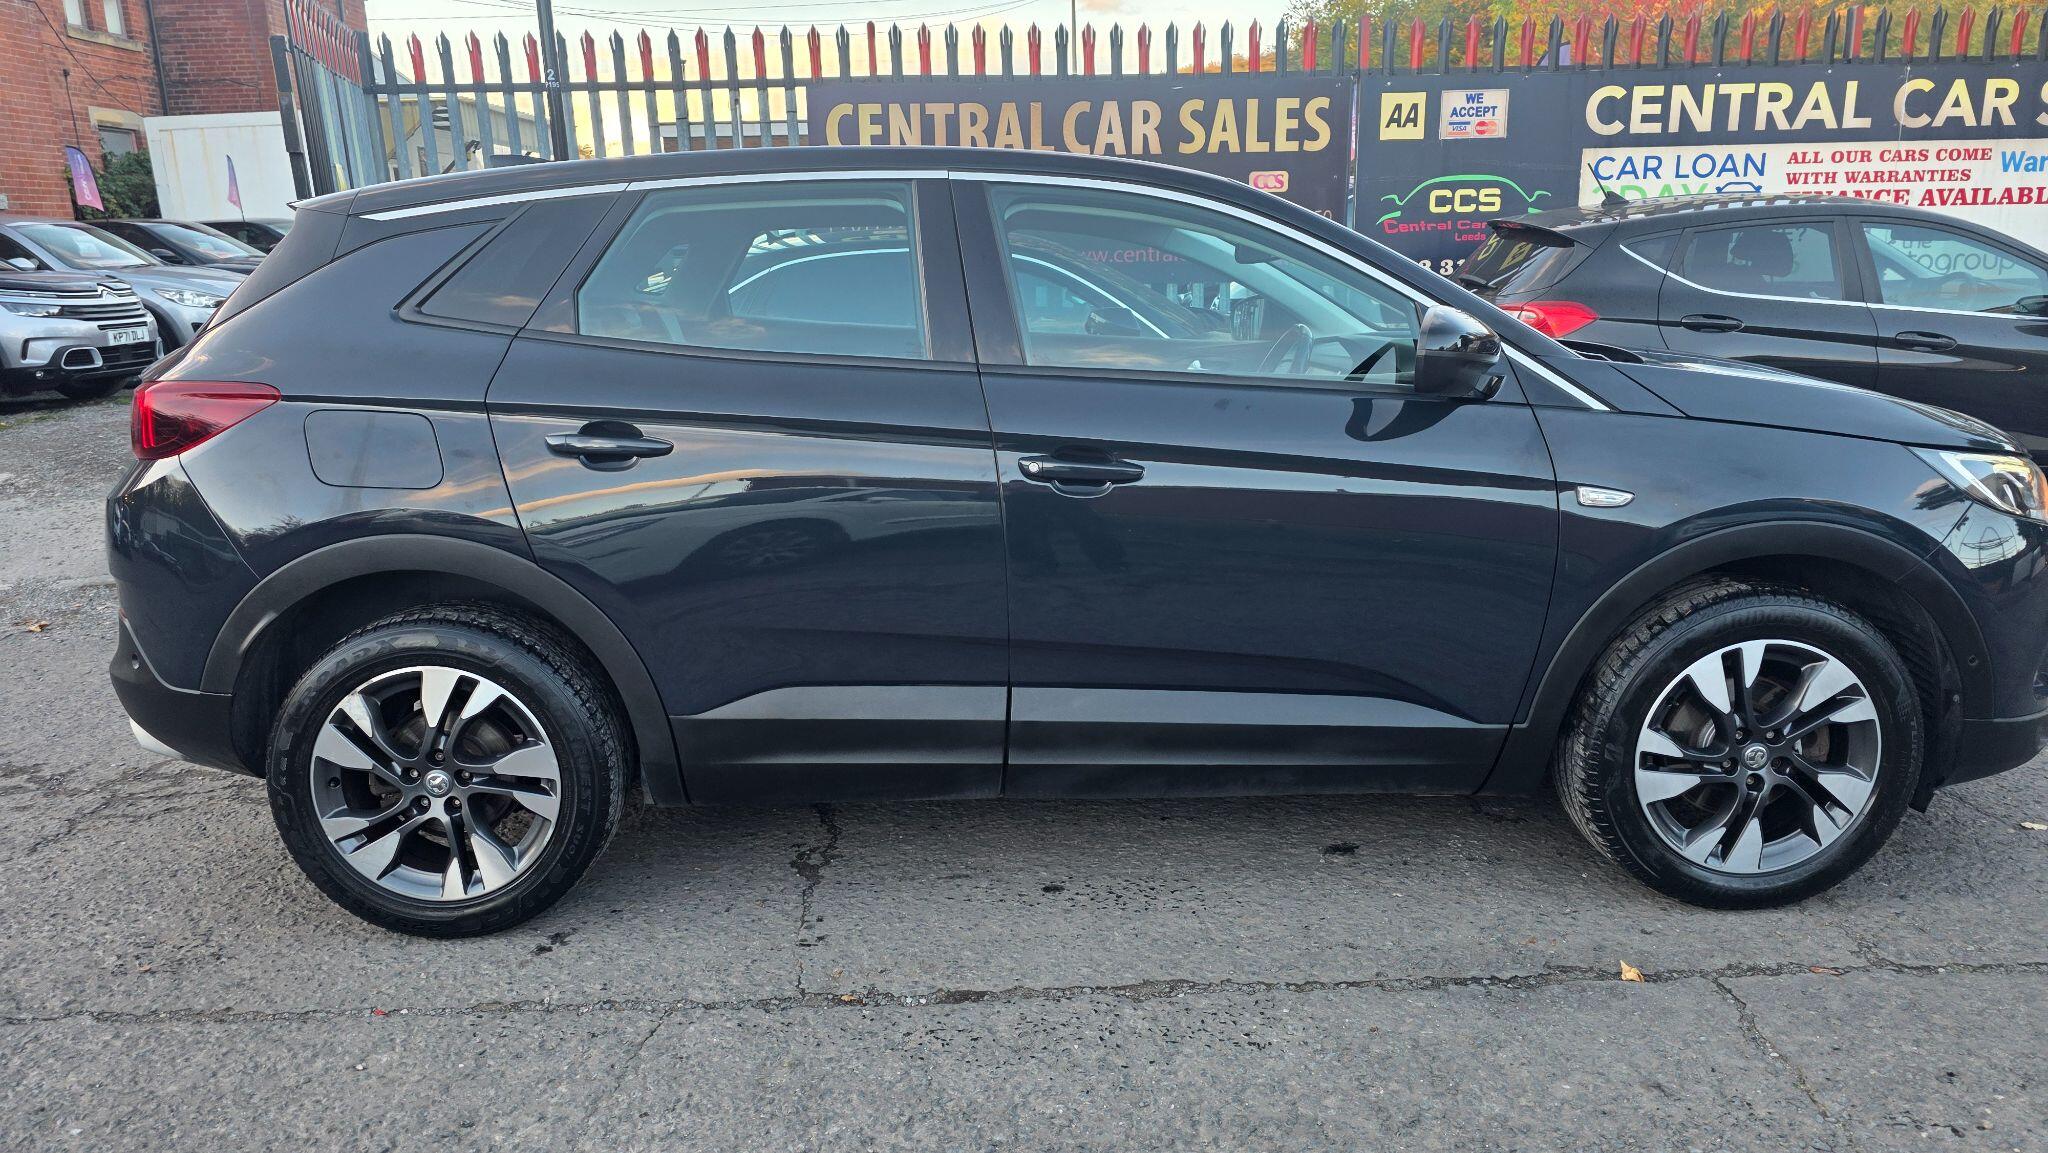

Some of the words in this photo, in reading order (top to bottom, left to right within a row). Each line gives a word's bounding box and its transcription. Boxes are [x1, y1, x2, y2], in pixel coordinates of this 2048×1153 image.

[547, 69, 555, 80] 2
[1466, 93, 1484, 104] WE
[1450, 105, 1498, 118] ACCEPT
[1585, 80, 1872, 136] CENTRAL
[1893, 78, 2019, 129] CAR
[1385, 103, 1418, 128] AA
[826, 102, 1055, 152] CENTRAL
[1062, 101, 1162, 155] CAR
[1179, 97, 1331, 154] SALES
[1787, 151, 1824, 165] ALL
[1831, 150, 1872, 164] OUR
[1884, 149, 1929, 163] CARS
[1935, 148, 1992, 162] COME
[1594, 155, 1663, 181] CAR
[1675, 152, 1766, 179] LOAN
[1786, 171, 1837, 185] WITH
[1844, 169, 1971, 184] WARRANTIES
[1429, 187, 1501, 214] CCS
[1383, 219, 1452, 234] Central
[1457, 220, 1487, 230] Car
[1455, 233, 1486, 241] Leeds
